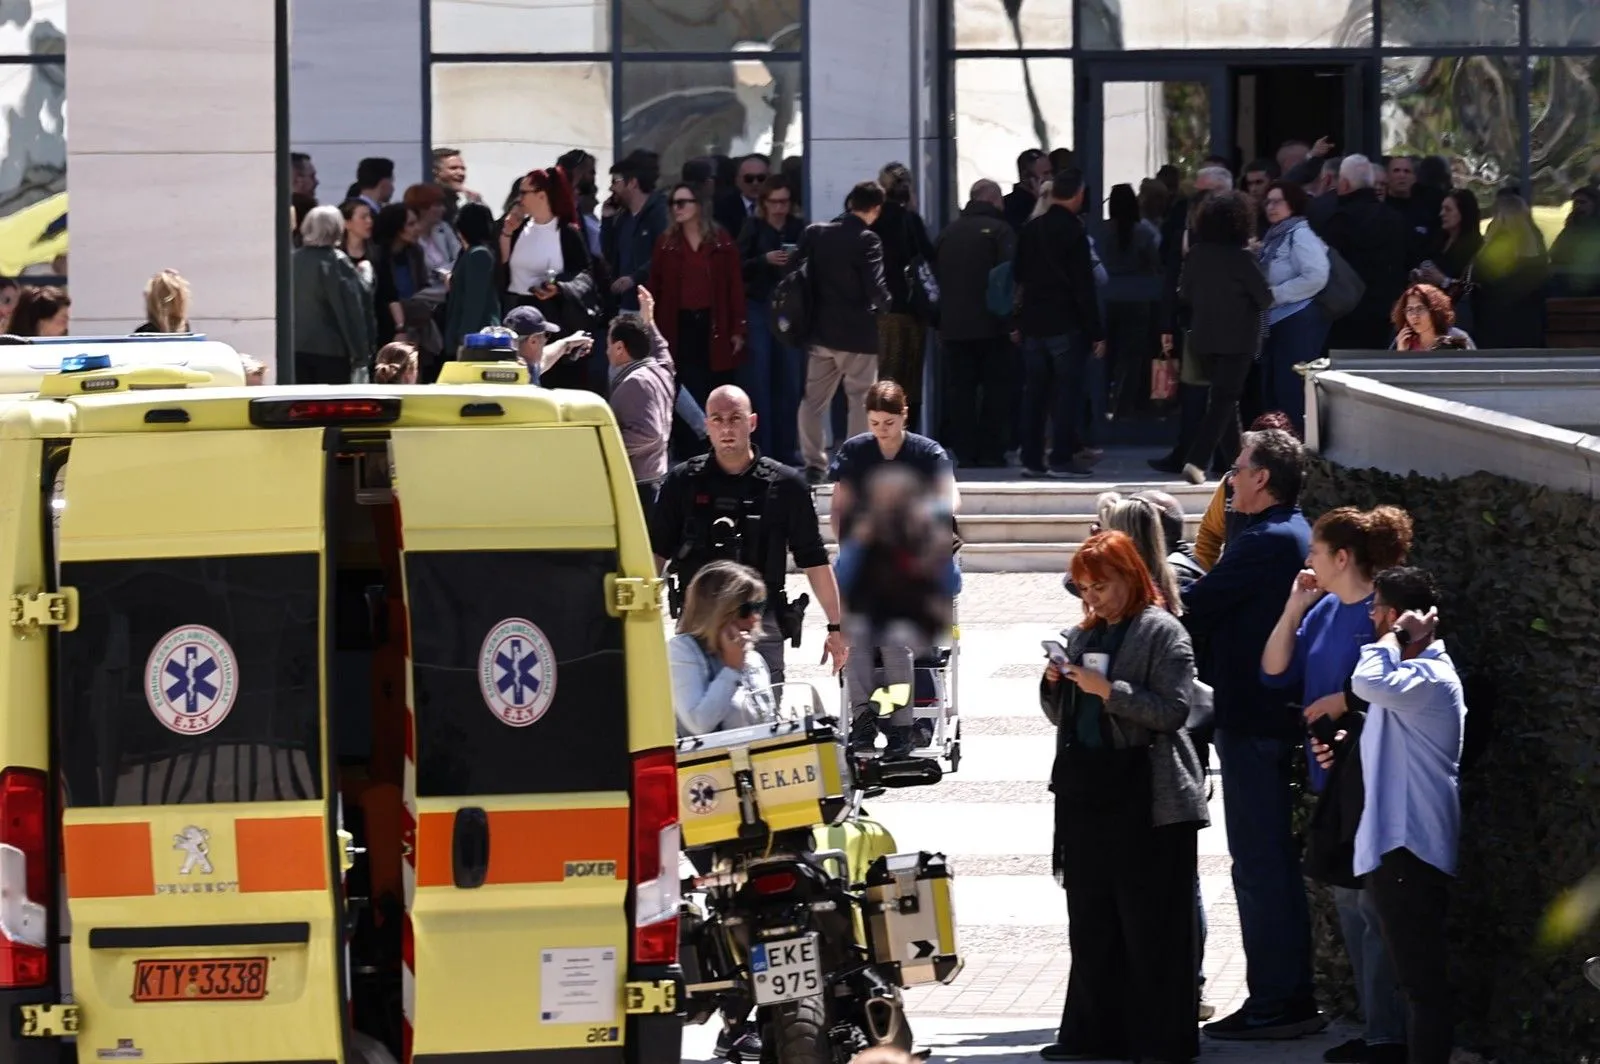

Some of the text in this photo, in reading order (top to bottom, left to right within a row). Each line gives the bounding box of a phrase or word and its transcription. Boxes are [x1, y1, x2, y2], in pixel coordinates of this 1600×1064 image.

[565, 862, 616, 877] BOXER
[768, 942, 814, 968] EKE
[772, 969, 817, 995] 975
